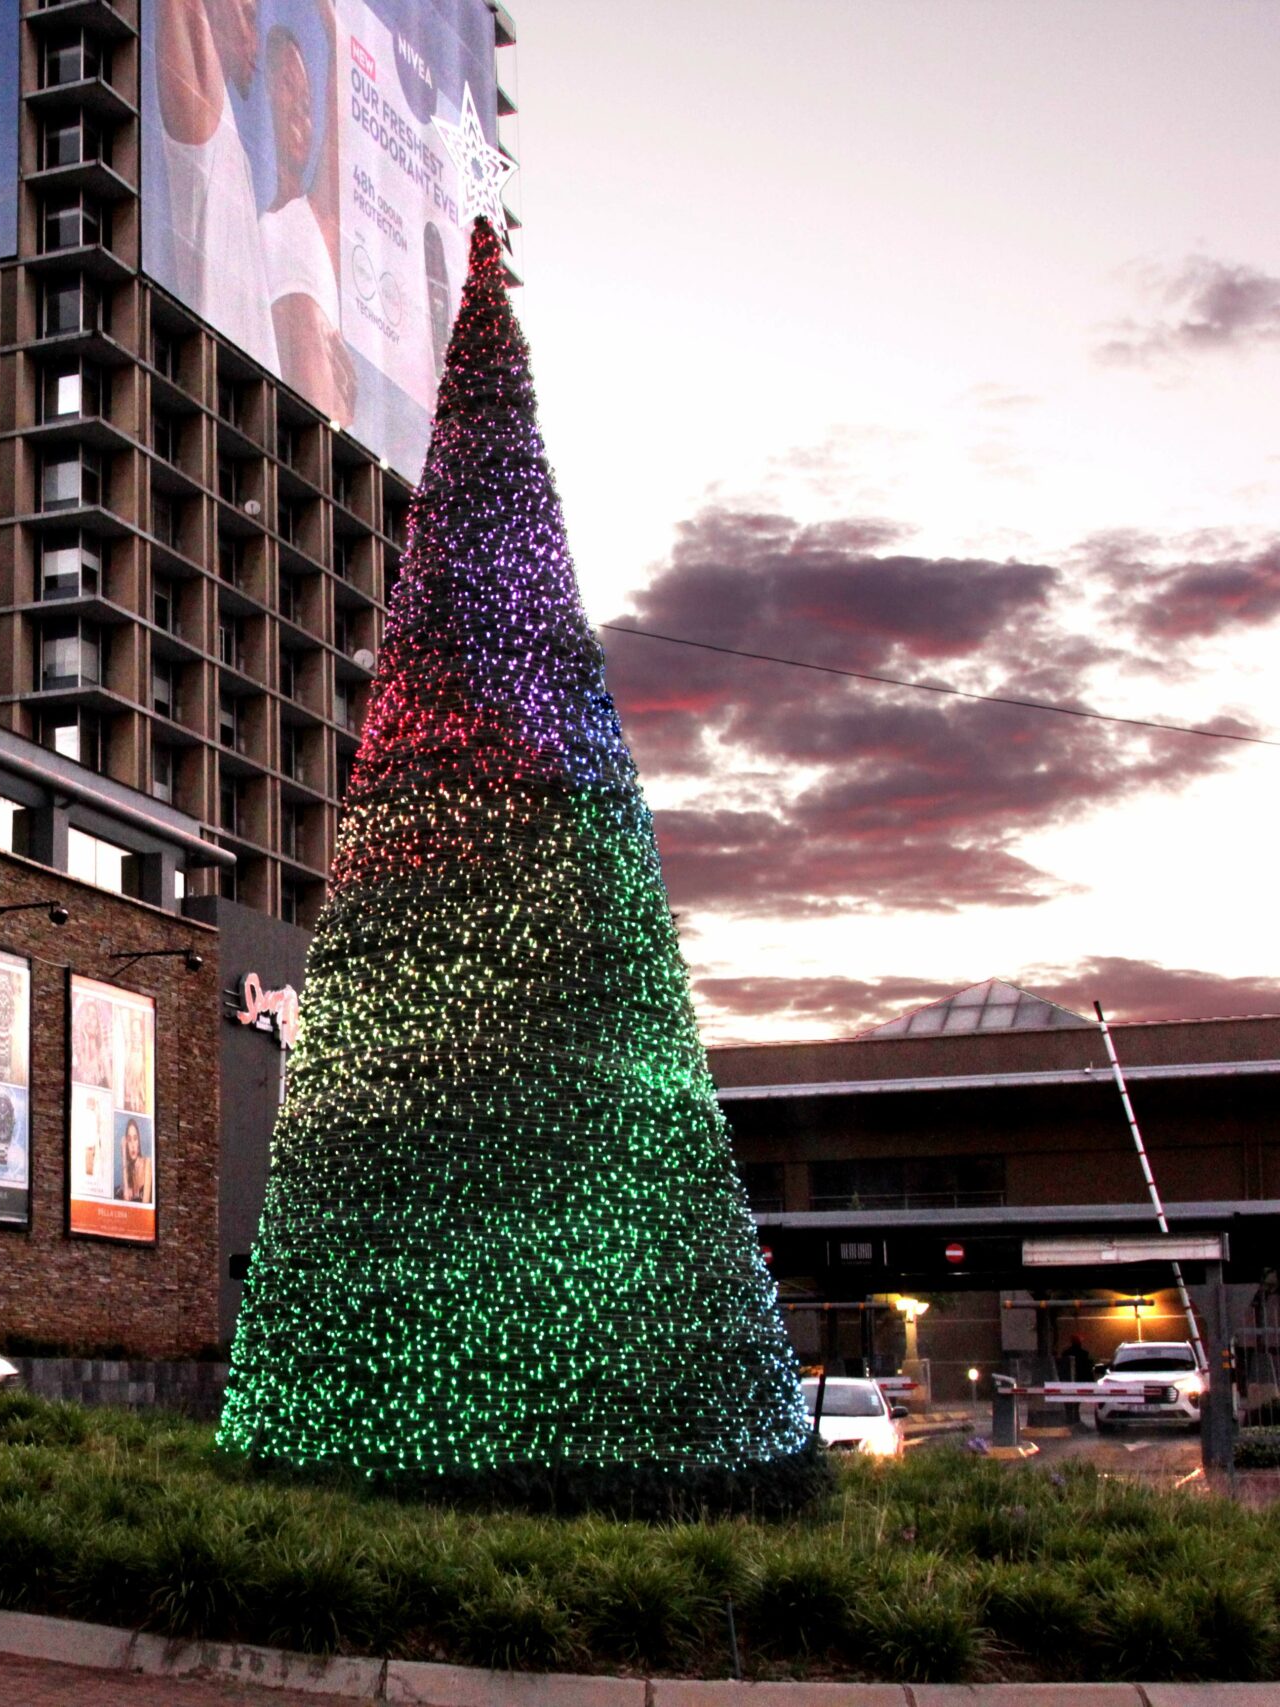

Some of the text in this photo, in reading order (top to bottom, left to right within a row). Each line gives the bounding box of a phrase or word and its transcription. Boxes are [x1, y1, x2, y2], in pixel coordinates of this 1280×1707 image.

[351, 40, 375, 76] NEW
[398, 32, 433, 89] NIVEA
[351, 67, 444, 182] OUR FRESHEST
[351, 95, 459, 226] DEODORANT EVE
[353, 164, 376, 201] 48h
[353, 189, 408, 251] PROTECTION
